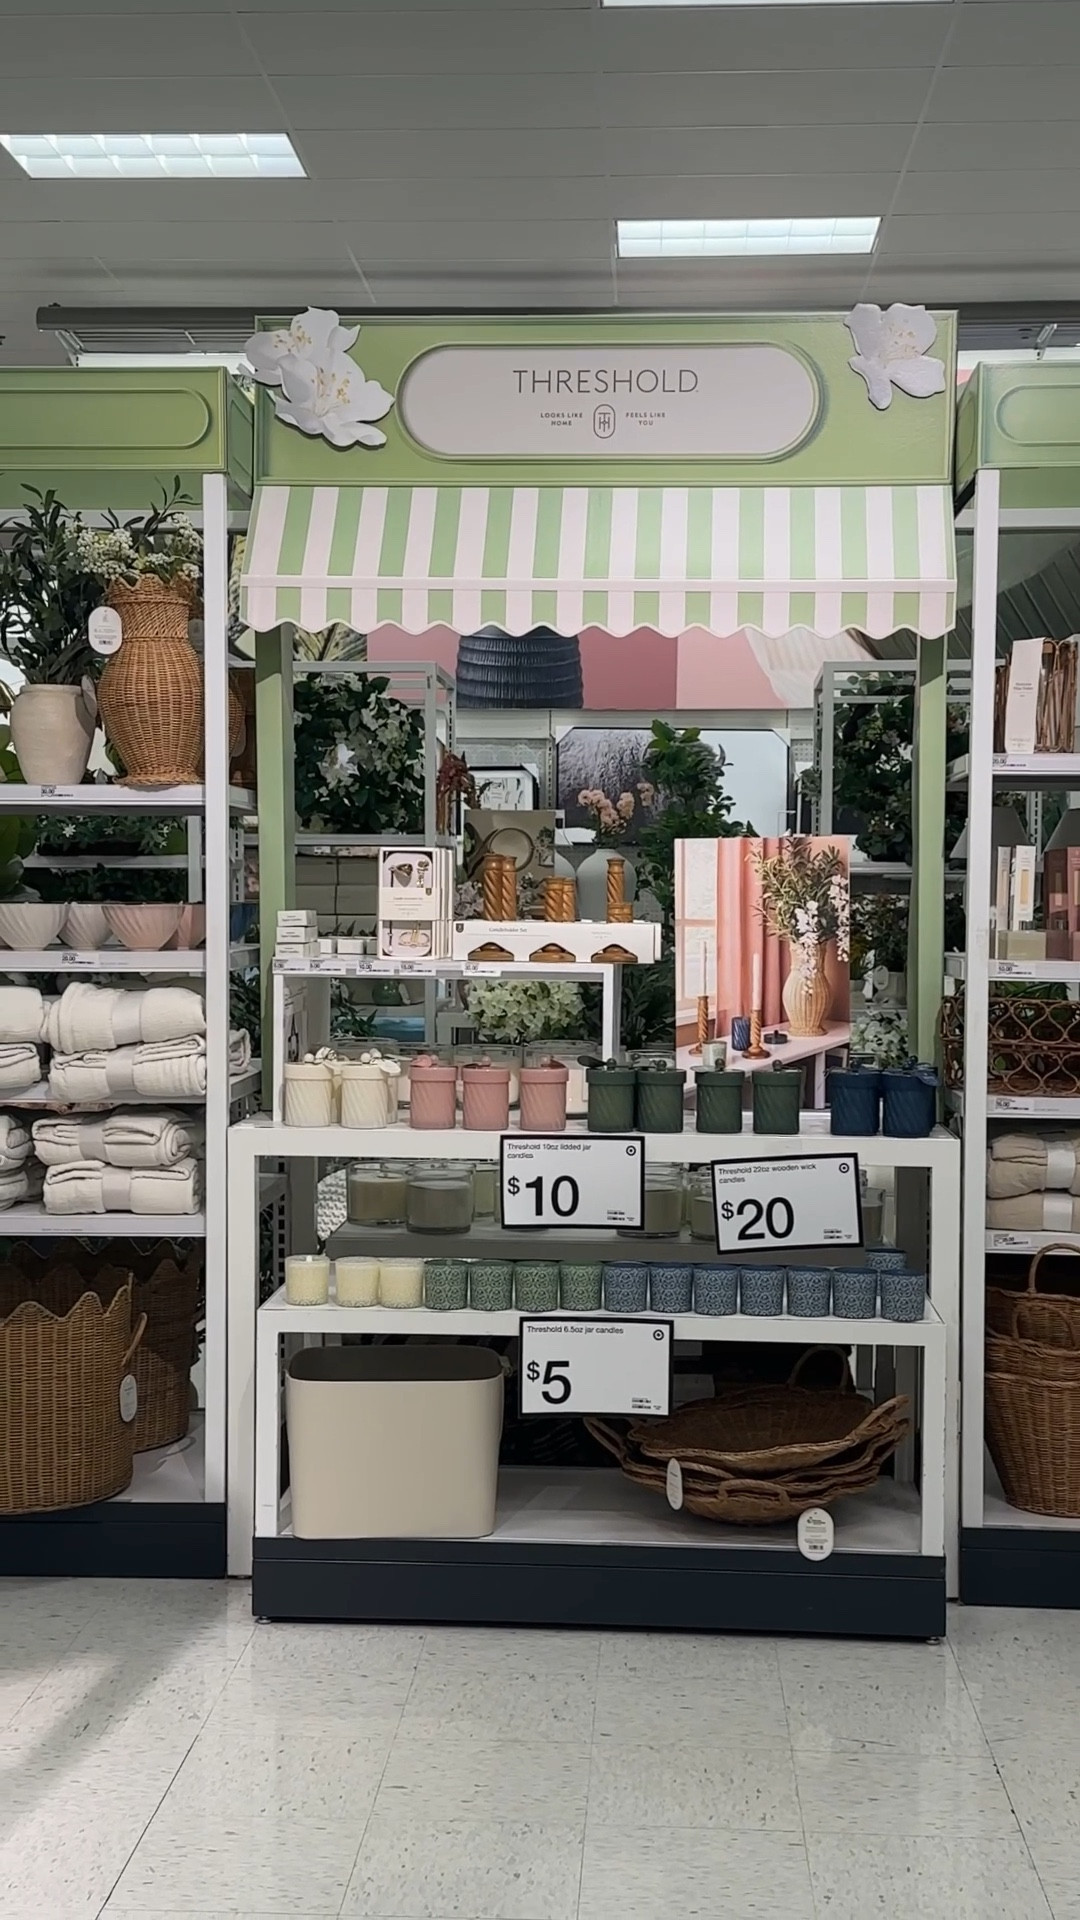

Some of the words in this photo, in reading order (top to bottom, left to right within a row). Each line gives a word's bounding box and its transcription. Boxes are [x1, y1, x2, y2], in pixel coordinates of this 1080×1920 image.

[513, 369, 698, 394] THRESHOLD
[560, 1143, 582, 1151] lidded
[582, 1144, 592, 1152] jar
[718, 1166, 752, 1175] Threshold
[772, 1164, 799, 1172] wooden
[507, 1175, 580, 1217] $10
[721, 1196, 795, 1241] $20
[527, 1325, 563, 1333] Threshold
[564, 1325, 583, 1333] 6.5oz
[584, 1326, 595, 1335] jar
[526, 1360, 572, 1405] $5
